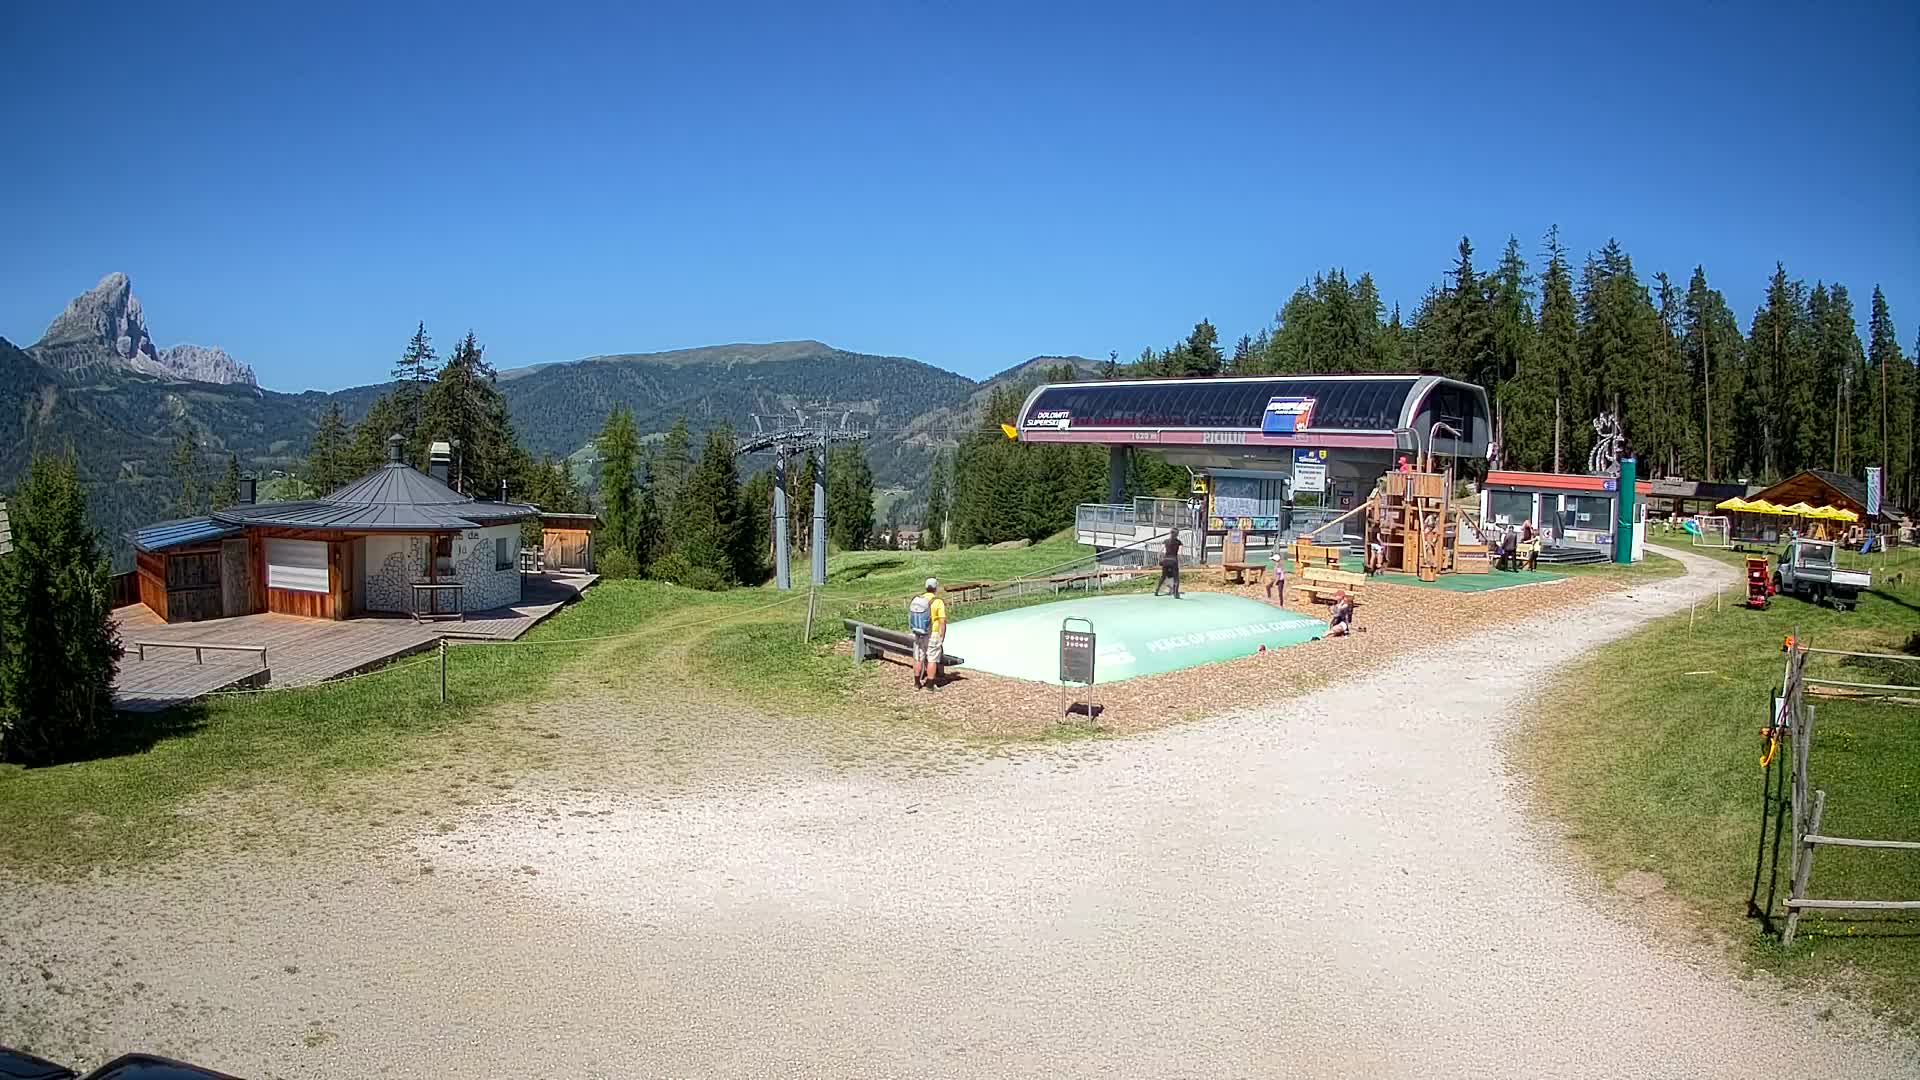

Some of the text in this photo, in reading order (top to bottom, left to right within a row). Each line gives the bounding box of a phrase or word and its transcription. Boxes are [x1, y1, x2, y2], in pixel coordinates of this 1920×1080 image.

[1037, 411, 1070, 419] DOLOMITI
[1202, 431, 1246, 444] PICULIN
[1145, 635, 1190, 653] PEACE
[1249, 624, 1270, 634] ALL
